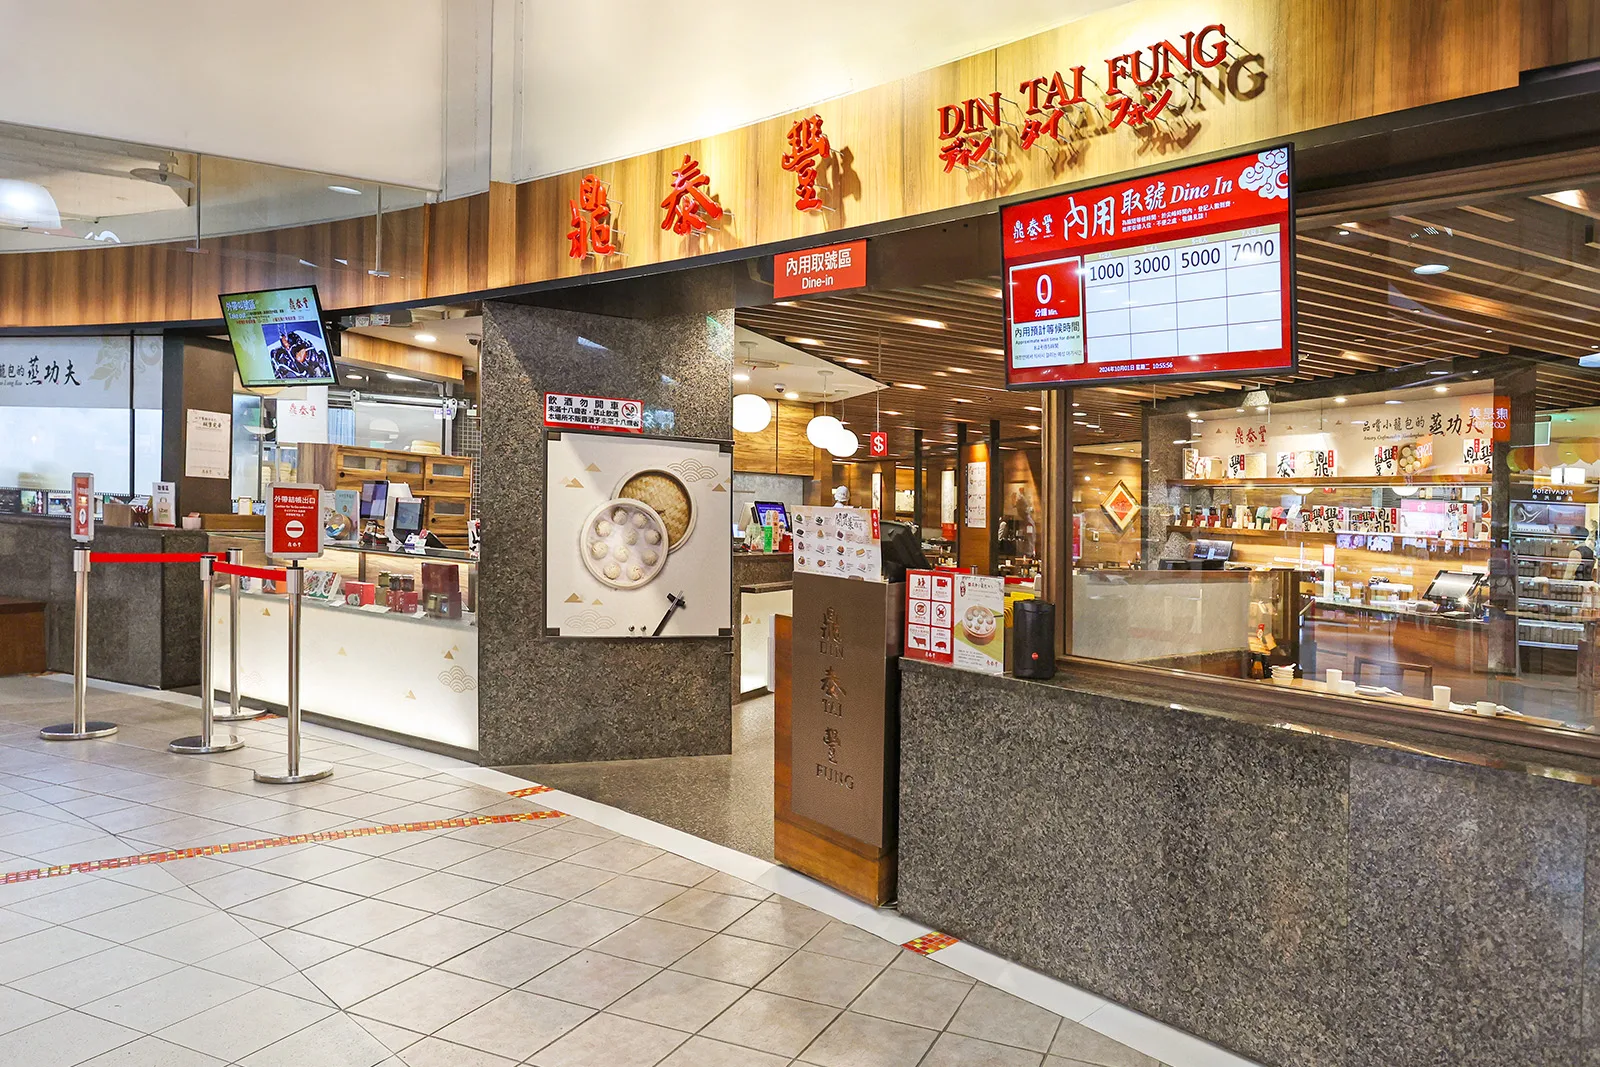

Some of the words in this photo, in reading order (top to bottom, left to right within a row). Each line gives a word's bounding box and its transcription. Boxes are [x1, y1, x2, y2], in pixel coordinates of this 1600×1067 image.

[937, 91, 1002, 140] DIN
[1020, 65, 1087, 115] TAI
[1104, 23, 1229, 95] FUNG
[938, 135, 992, 173] ディン
[1020, 107, 1064, 150] タイ
[1105, 88, 1173, 128] フォン
[567, 113, 830, 260] 鼎泰豐
[1170, 183, 1210, 205] Dine
[1213, 176, 1233, 196] In
[1013, 214, 1053, 239] 鼎泰豐
[786, 248, 852, 277] 內用取號區
[1090, 262, 1124, 281] 1000
[1134, 255, 1171, 275] 3000
[1181, 247, 1220, 269] 5000
[802, 274, 833, 289] Dine-in
[1037, 274, 1052, 304] 0
[548, 395, 619, 410] 飲酒勿開車
[874, 435, 884, 453] $
[1235, 425, 1267, 444] 鼎泰豐
[274, 495, 315, 504] 外帶結帳出口
[819, 640, 844, 660] DIN
[820, 666, 846, 699] 泰
[822, 698, 842, 718] TAI
[816, 763, 854, 790] FUNG
